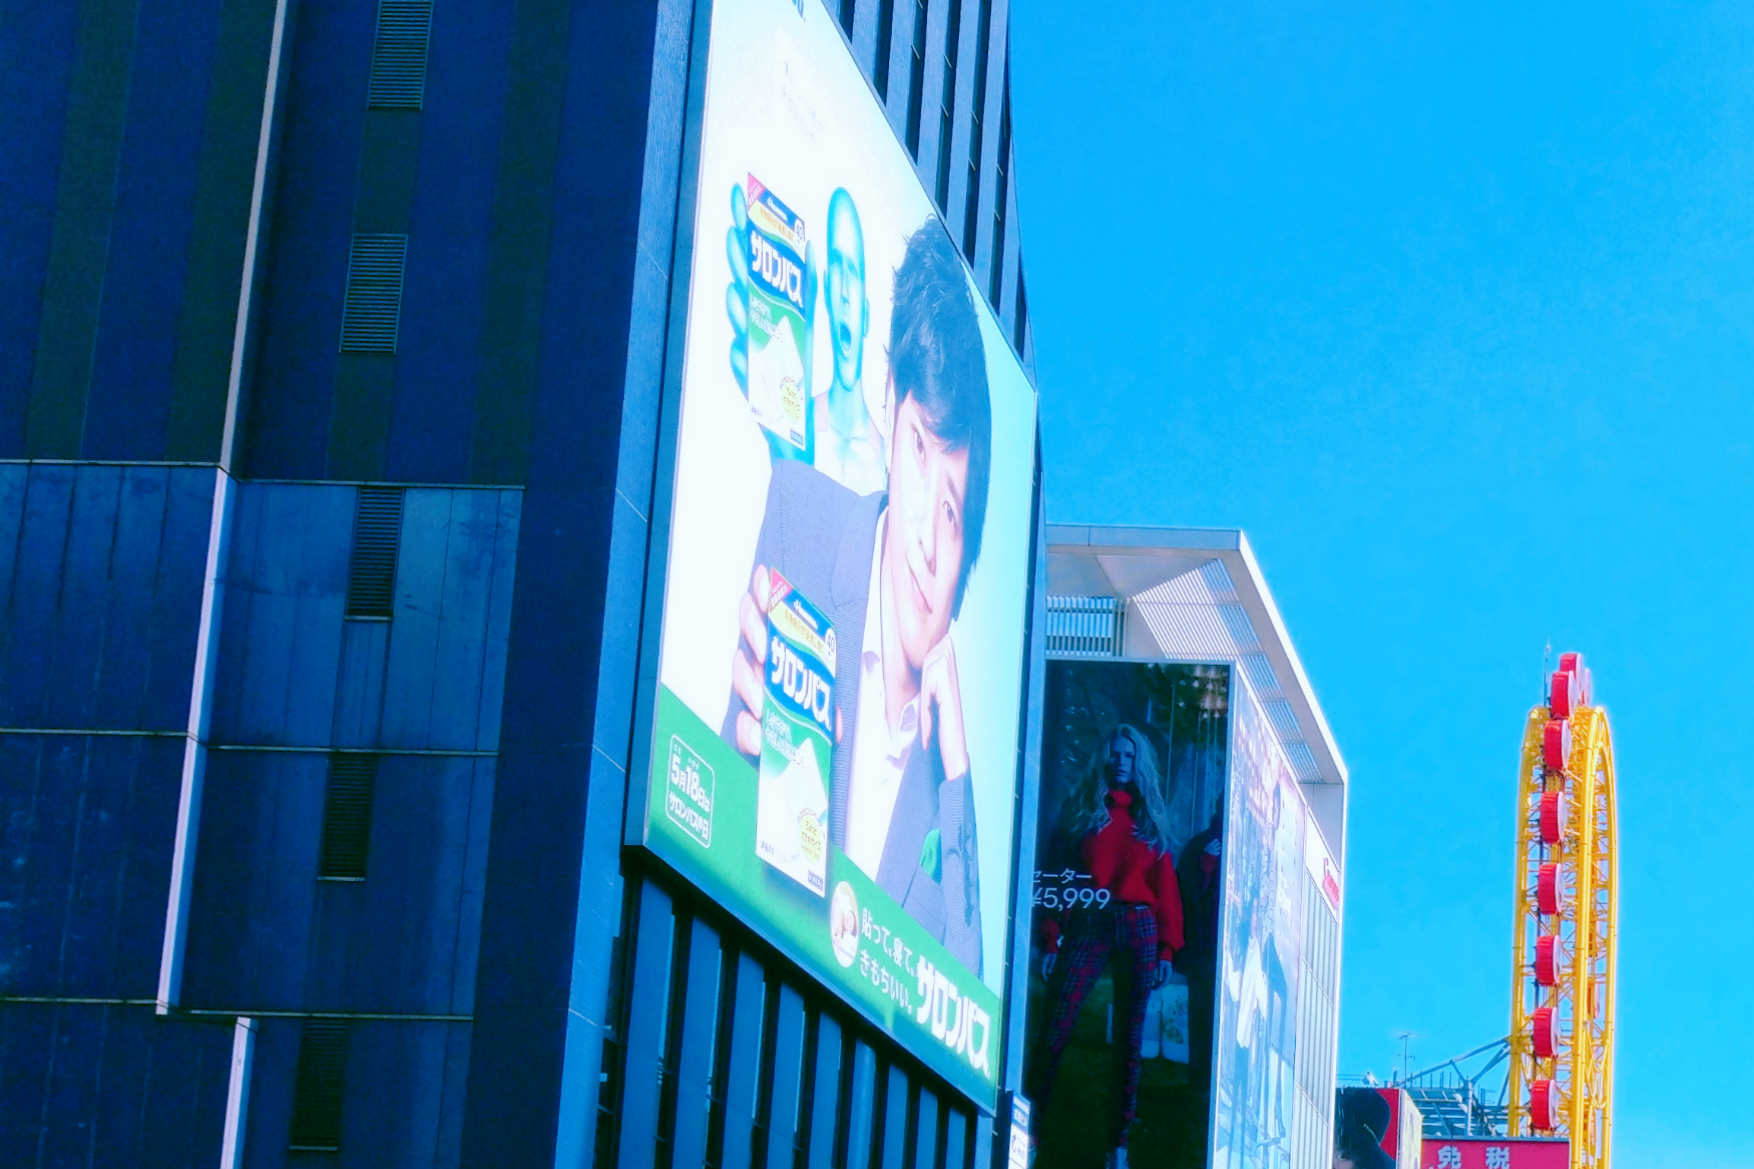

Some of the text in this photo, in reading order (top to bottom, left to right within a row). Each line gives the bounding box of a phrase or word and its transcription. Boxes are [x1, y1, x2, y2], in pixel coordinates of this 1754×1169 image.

[770, 635, 833, 733] サロンパス
[916, 954, 991, 1080] サロンパス
